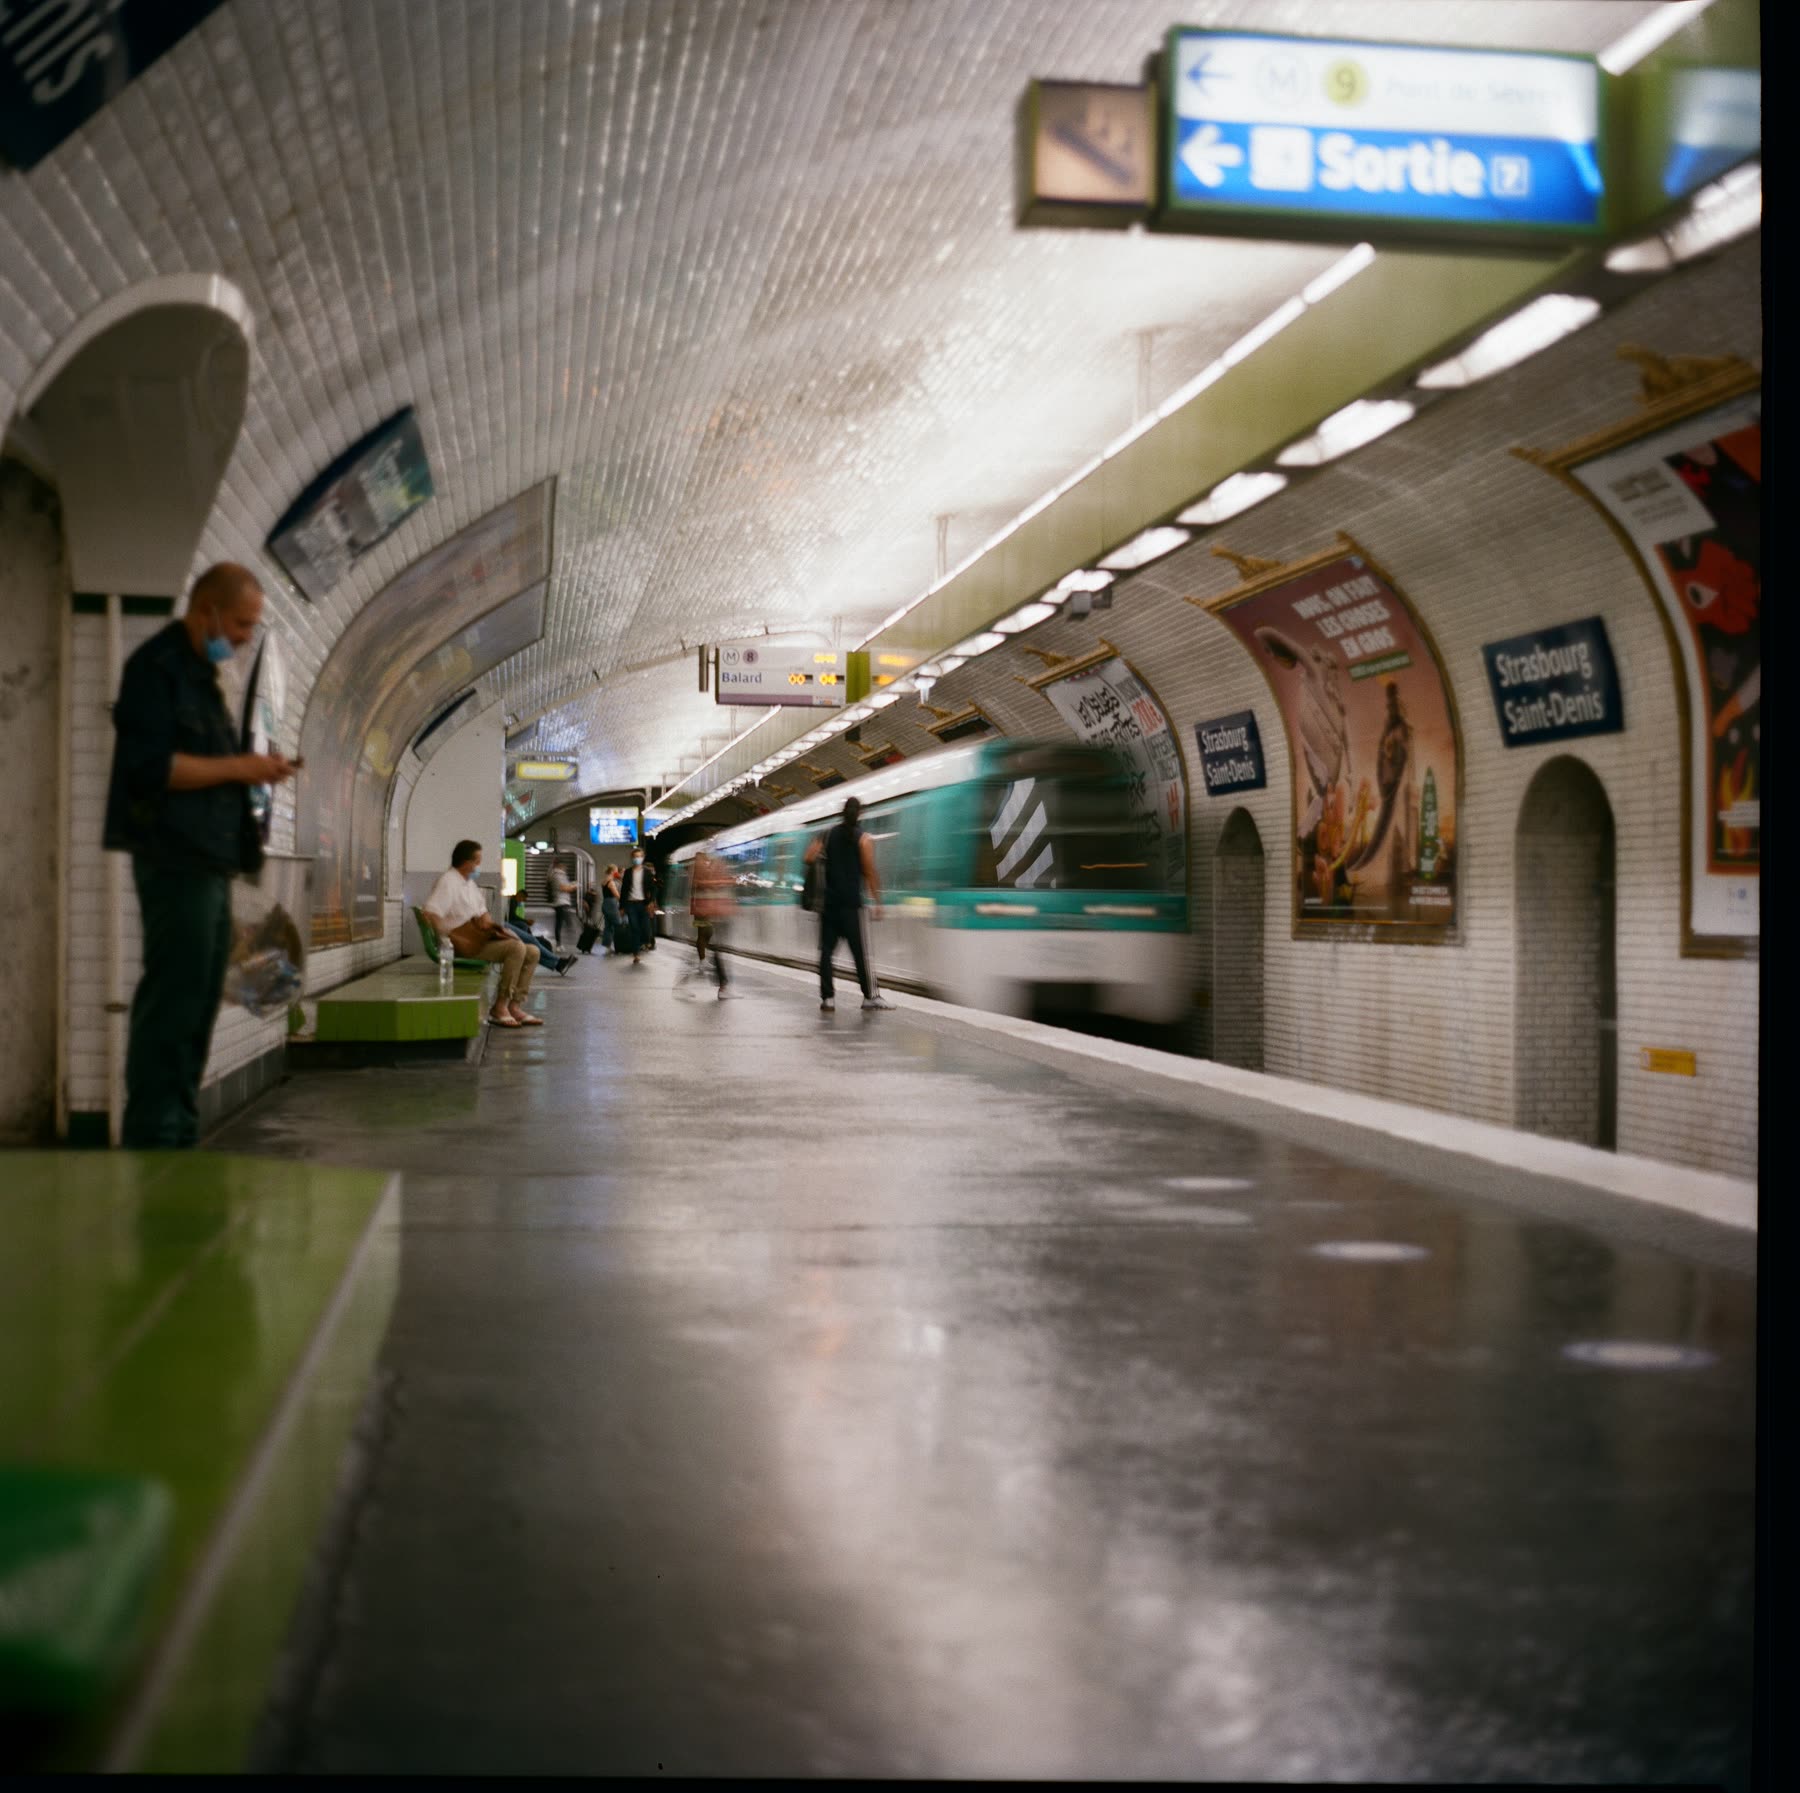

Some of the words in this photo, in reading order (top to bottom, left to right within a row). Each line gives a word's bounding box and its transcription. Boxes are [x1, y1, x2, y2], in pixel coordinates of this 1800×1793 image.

[1335, 66, 1358, 101] 9
[1317, 132, 1487, 197] Sortie
[722, 672, 762, 683] Balard
[1496, 642, 1593, 688] Strasbourg
[1504, 684, 1605, 734] Saint-Denis
[1201, 725, 1249, 754] Strasbourg
[1206, 754, 1256, 787] Saint-Denis
